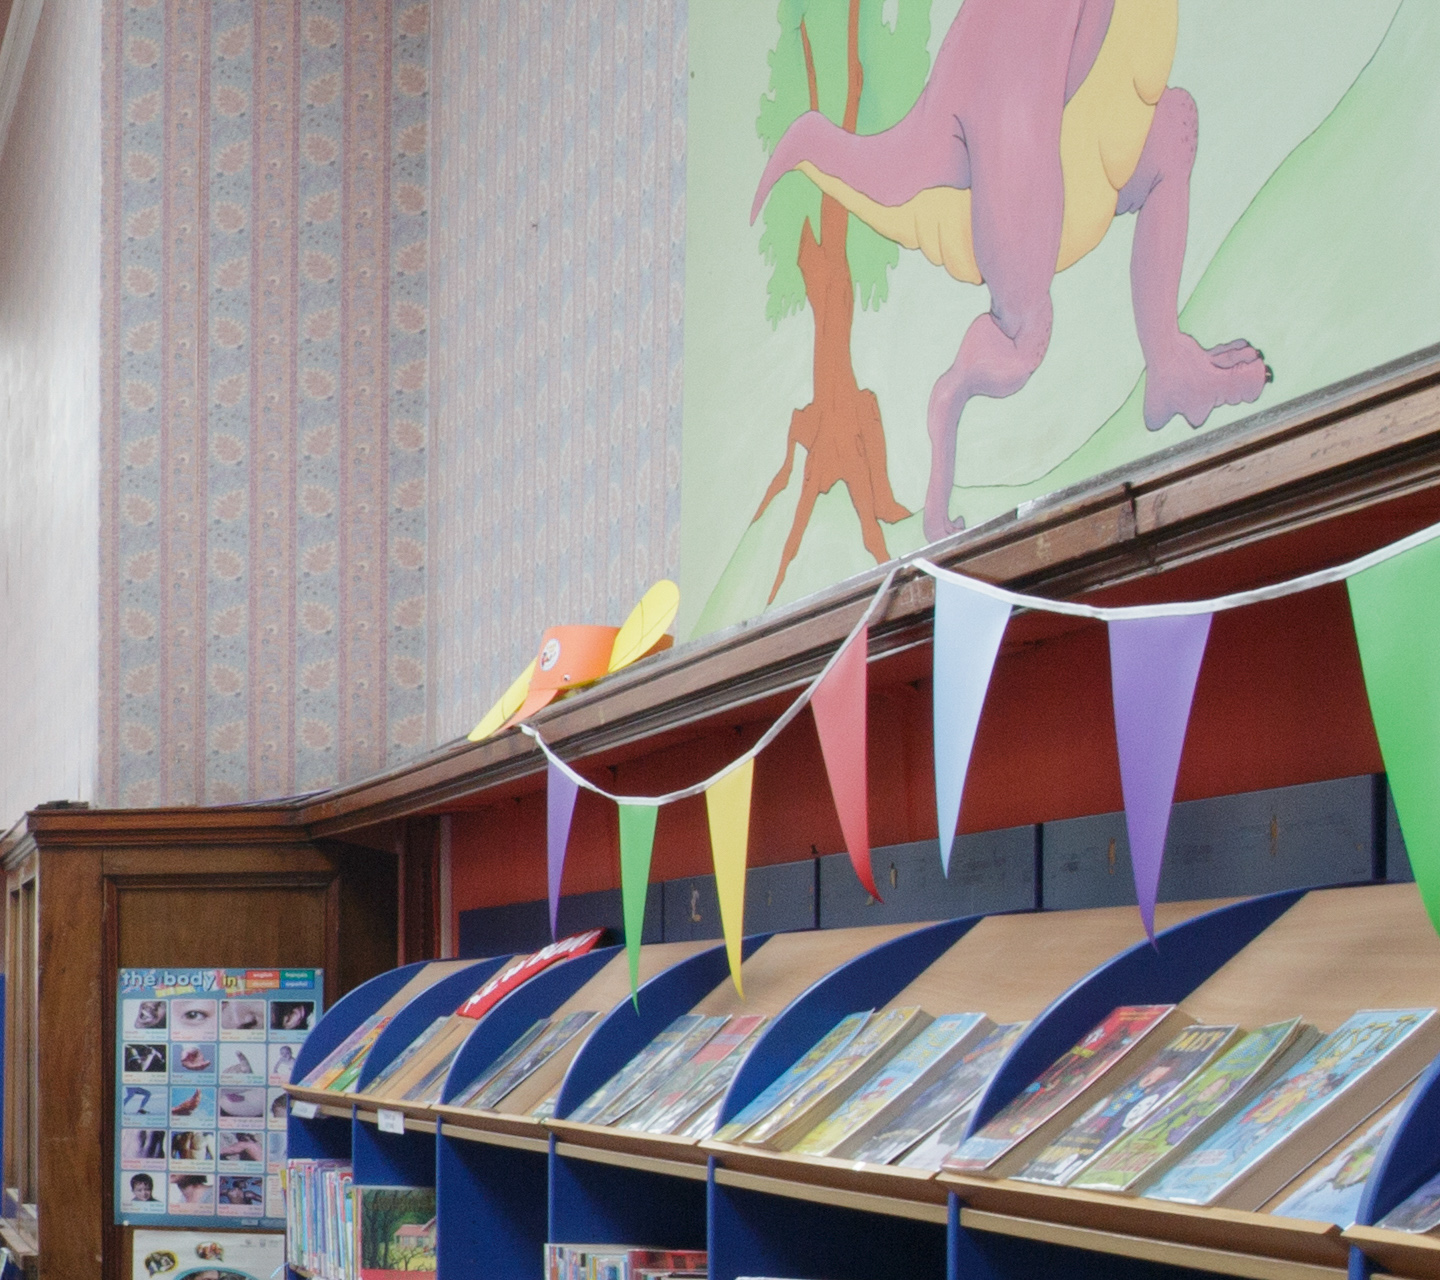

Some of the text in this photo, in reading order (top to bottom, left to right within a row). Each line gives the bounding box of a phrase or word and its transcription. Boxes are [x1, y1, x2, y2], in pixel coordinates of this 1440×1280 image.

[123, 971, 237, 991] the body in
